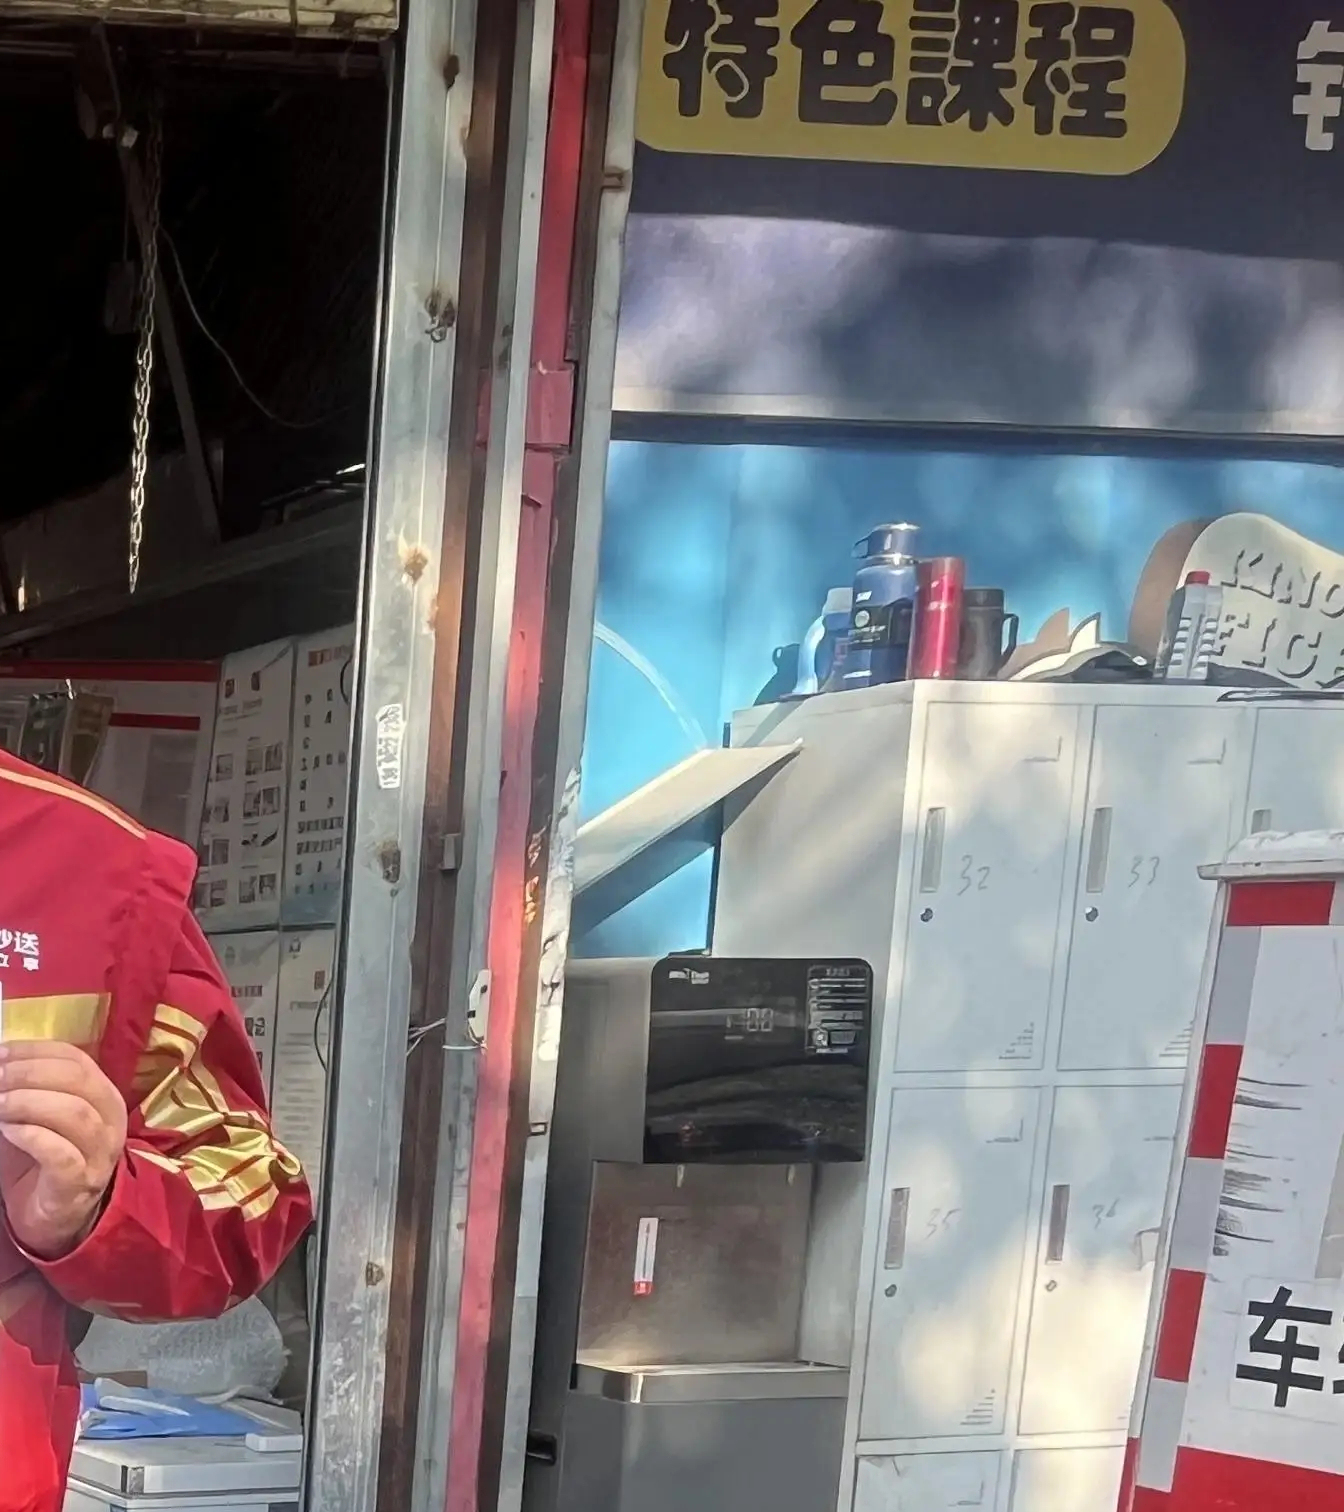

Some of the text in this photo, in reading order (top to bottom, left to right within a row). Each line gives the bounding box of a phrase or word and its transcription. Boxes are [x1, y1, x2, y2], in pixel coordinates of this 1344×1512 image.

[662, 0, 1135, 138] 特色課程
[957, 854, 991, 896] 32
[1128, 855, 1160, 887] 33
[1235, 1284, 1344, 1408] 车
